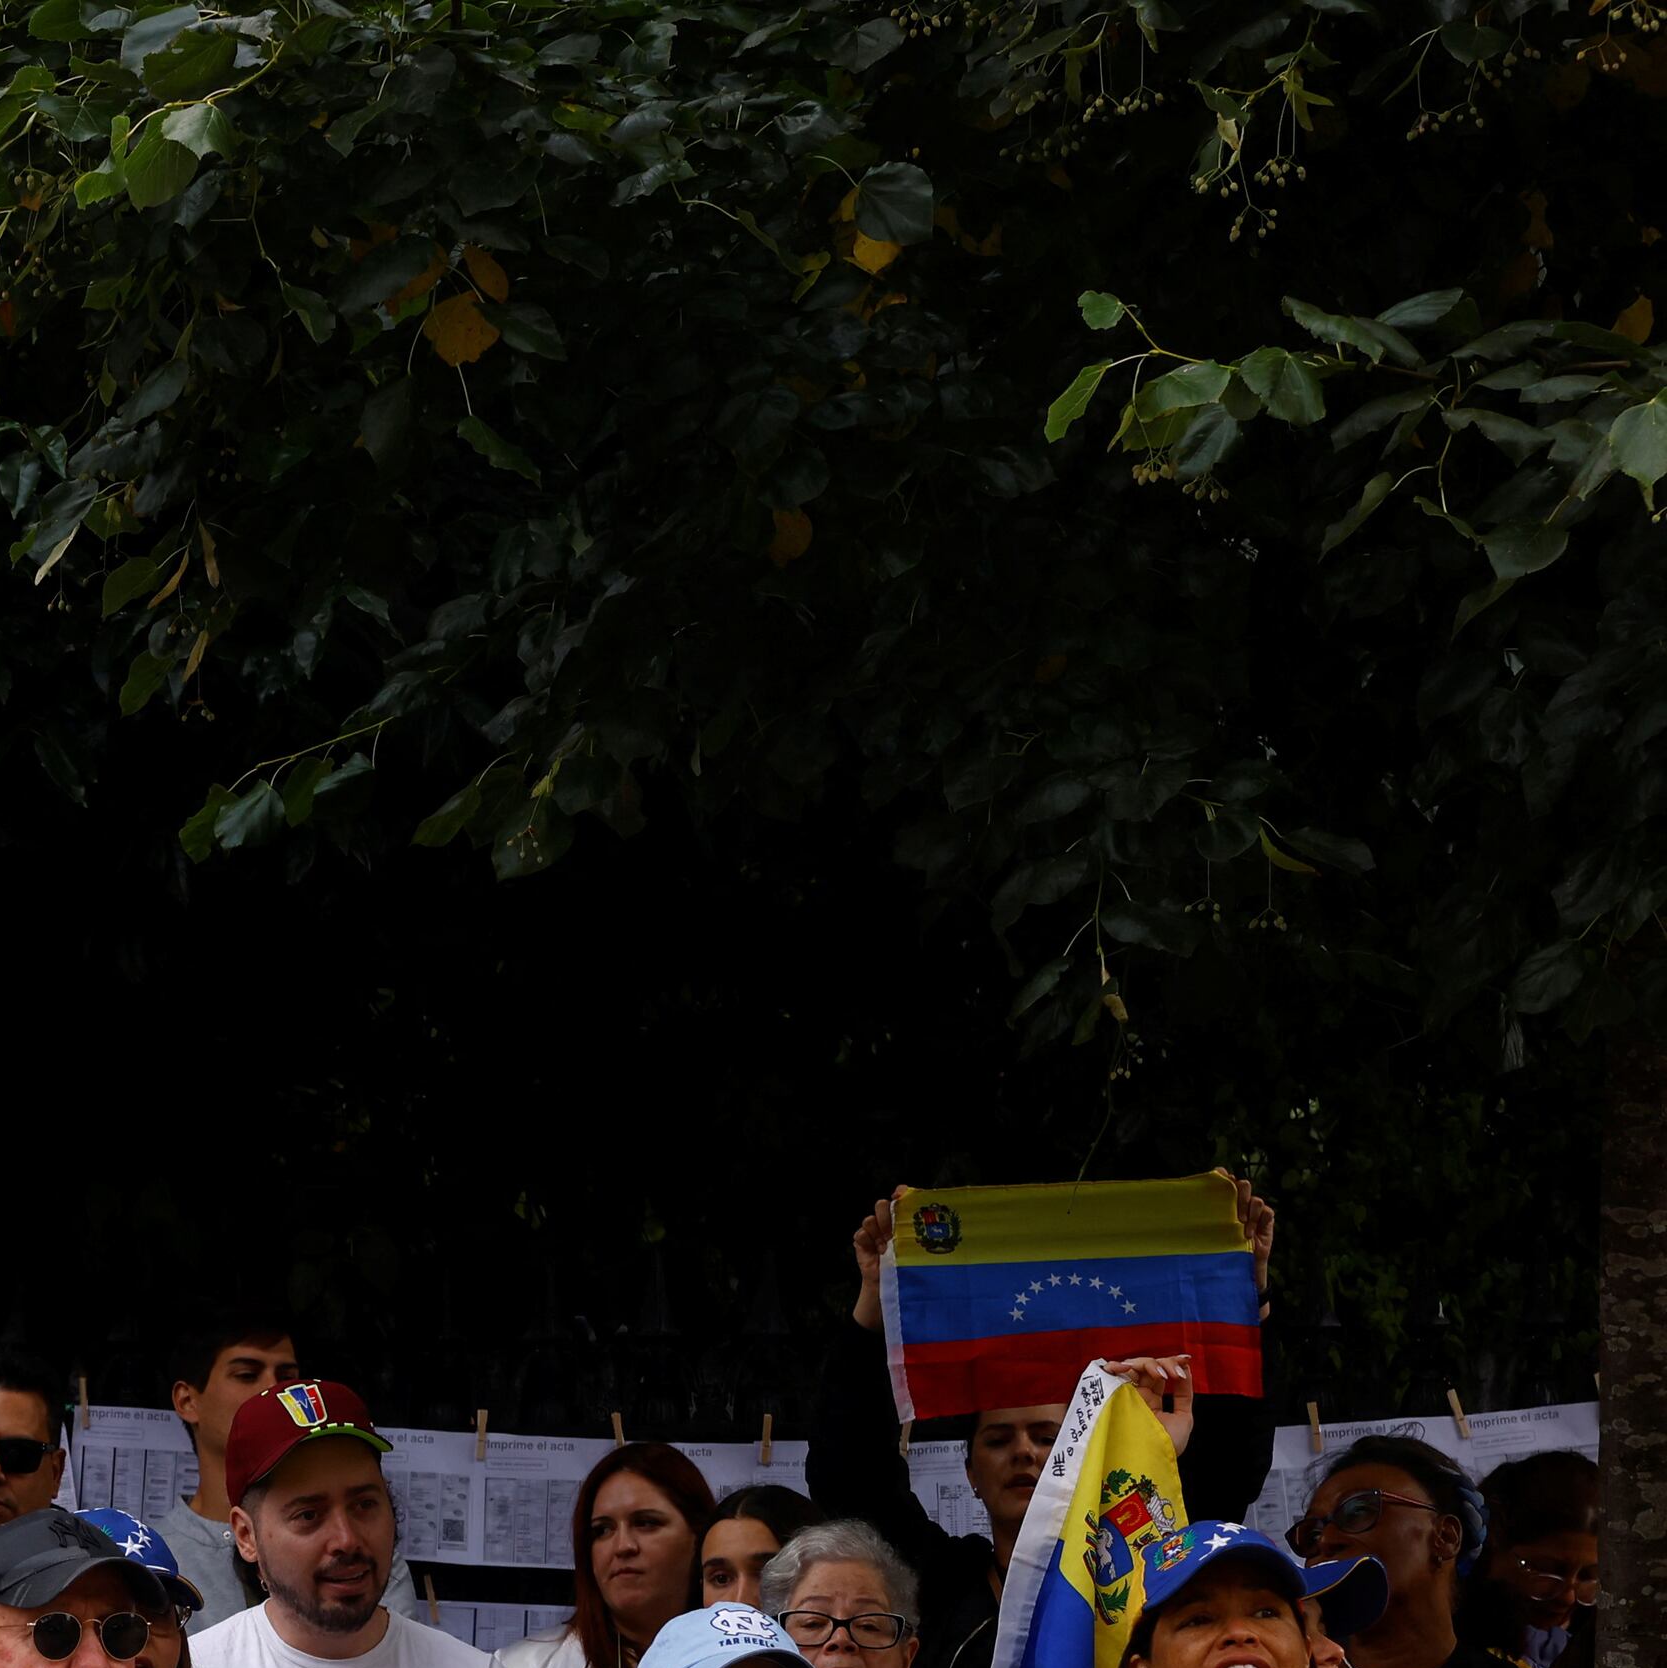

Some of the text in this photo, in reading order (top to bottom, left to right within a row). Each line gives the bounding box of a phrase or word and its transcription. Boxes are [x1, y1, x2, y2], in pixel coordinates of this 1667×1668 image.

[88, 1409, 130, 1420] mprime
[147, 1412, 171, 1422] acta
[1468, 1411, 1560, 1429] Imprime el acta
[410, 1434, 434, 1444] acta
[1323, 1428, 1372, 1439] Imprime
[486, 1440, 575, 1452] Imprime el acta
[908, 1444, 949, 1456] mprime
[688, 1448, 712, 1456] acta
[719, 1638, 740, 1647] TAR
